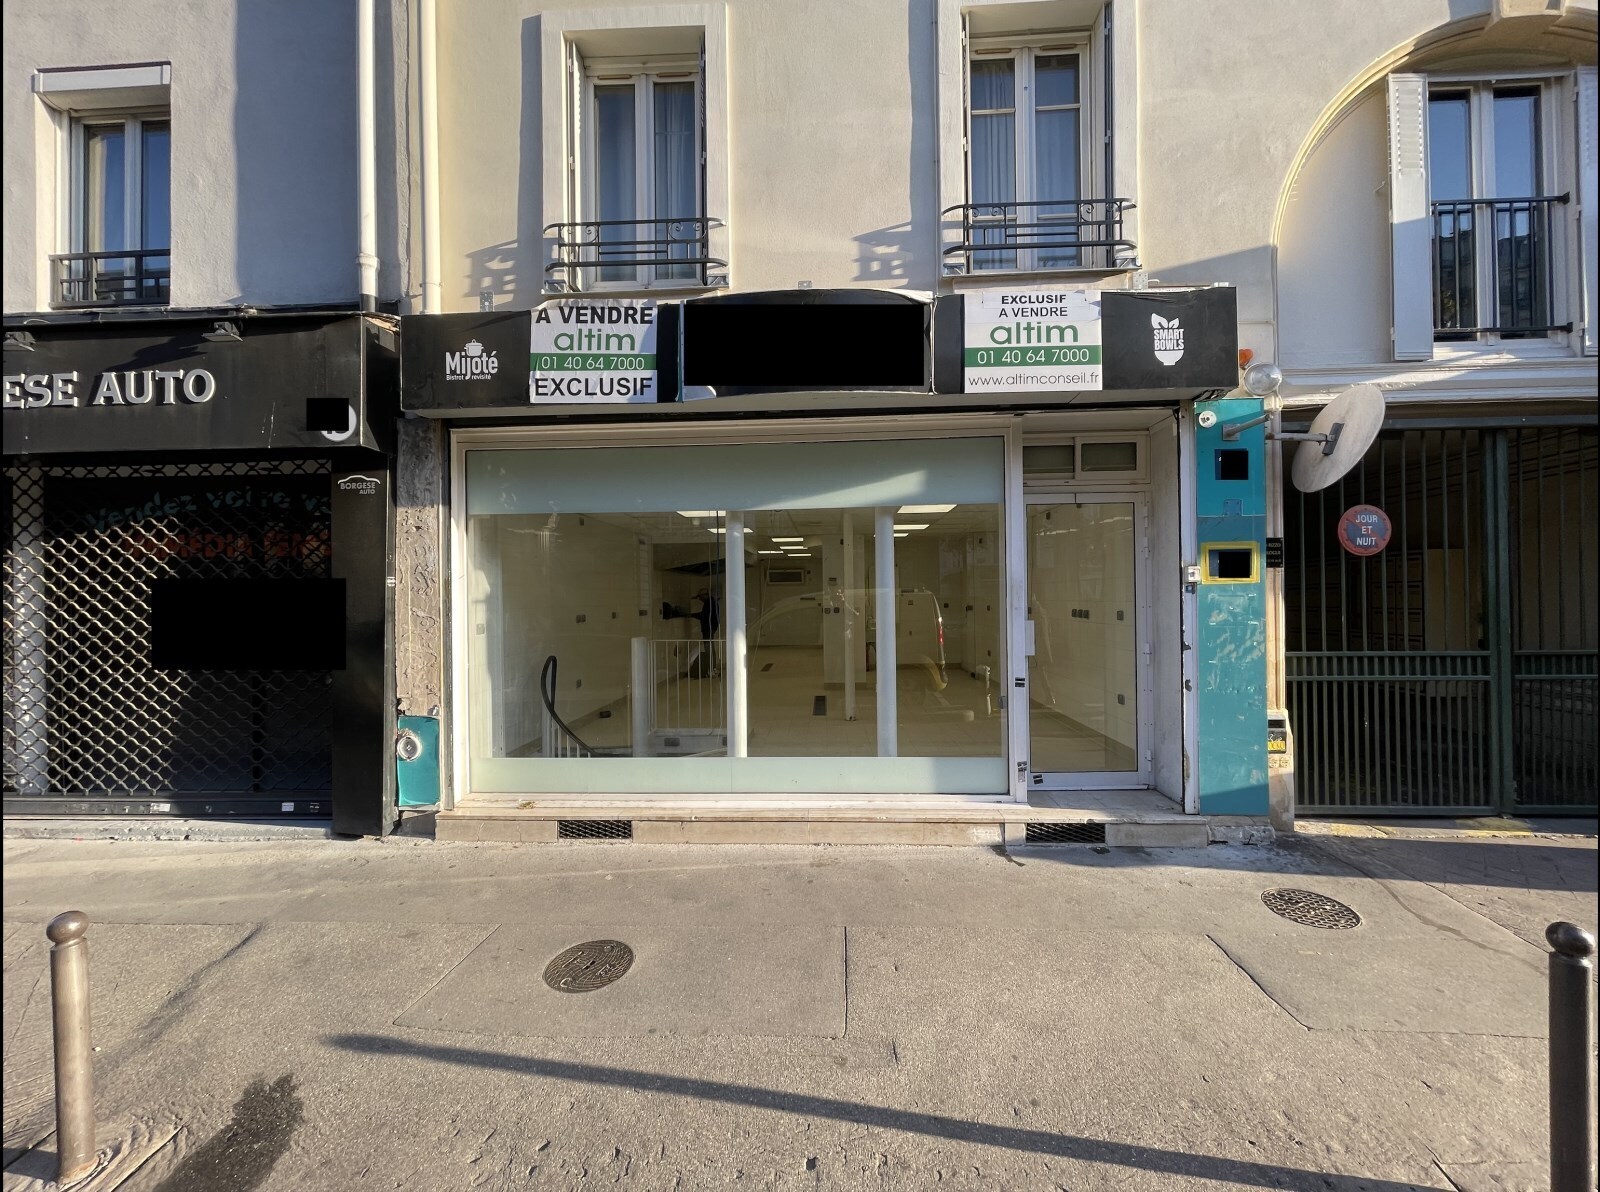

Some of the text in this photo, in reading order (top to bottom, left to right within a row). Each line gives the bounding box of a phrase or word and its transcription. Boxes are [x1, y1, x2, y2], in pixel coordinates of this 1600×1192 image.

[1001, 295, 1067, 305] EXCLUSIF
[535, 306, 654, 325] A VENDRE
[999, 306, 1069, 318] A VENDRE
[553, 328, 636, 352] altim
[989, 321, 1080, 345] altim
[1153, 328, 1185, 340] SMART
[1154, 339, 1185, 351] BOWLS
[541, 356, 645, 370] 01 40 64 7000
[977, 348, 1090, 364] 01 40 64 7000
[445, 351, 498, 380] Mijoté
[968, 372, 1100, 386] www.altimconseil.fr
[92, 368, 216, 406] AUTO
[534, 377, 653, 397] EXCLUSIF
[1355, 514, 1378, 524] JOUR
[1361, 525, 1373, 535] ET
[1356, 537, 1376, 546] NUIT
